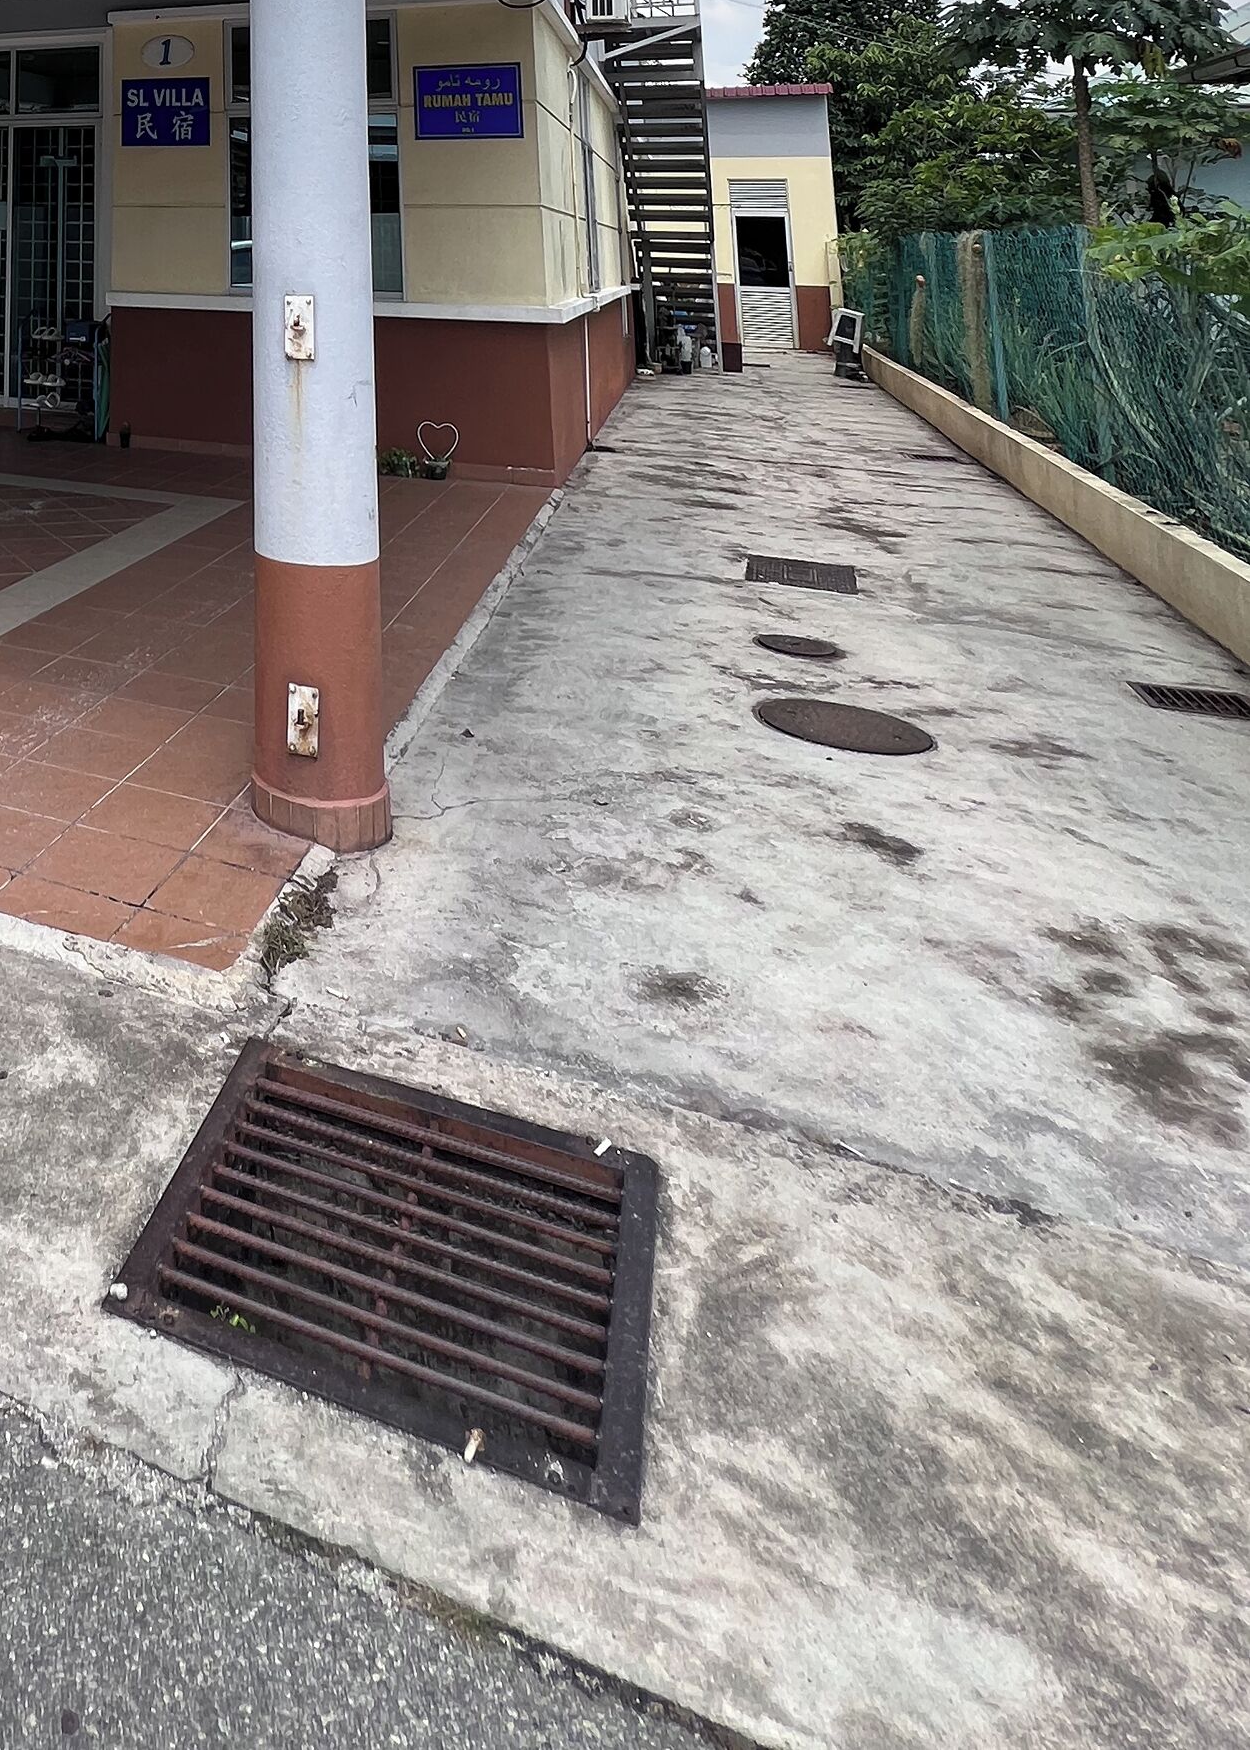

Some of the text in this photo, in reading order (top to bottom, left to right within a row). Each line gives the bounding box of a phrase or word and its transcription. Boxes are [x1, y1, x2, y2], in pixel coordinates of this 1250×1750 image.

[159, 38, 171, 66] 1
[126, 88, 204, 107] SL VILLA
[423, 92, 514, 108] RUMAH TAMU
[136, 111, 194, 141] 民宿
